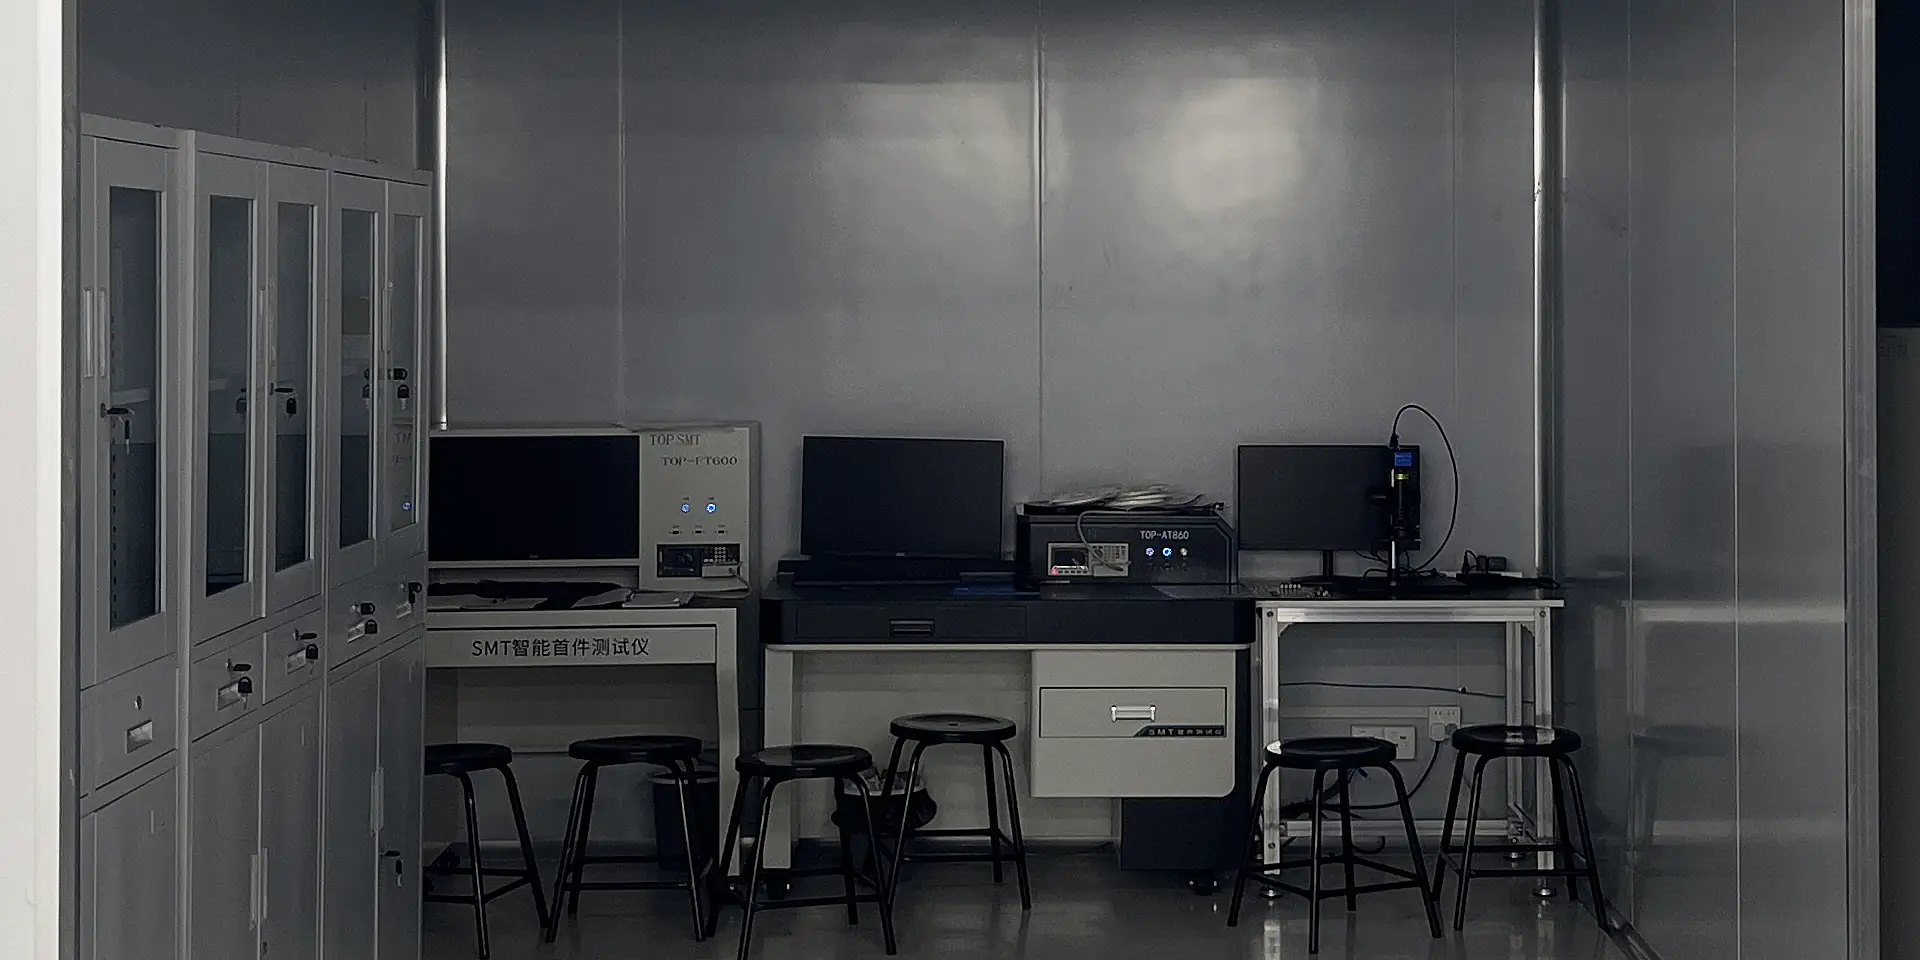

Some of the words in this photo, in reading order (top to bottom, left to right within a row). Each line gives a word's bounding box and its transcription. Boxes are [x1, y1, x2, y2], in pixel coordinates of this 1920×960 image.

[649, 433, 674, 446] TOP
[677, 433, 702, 446] SMT
[1140, 530, 1190, 540] TOP-AT860
[472, 638, 650, 658] SMT智能首件测试仪
